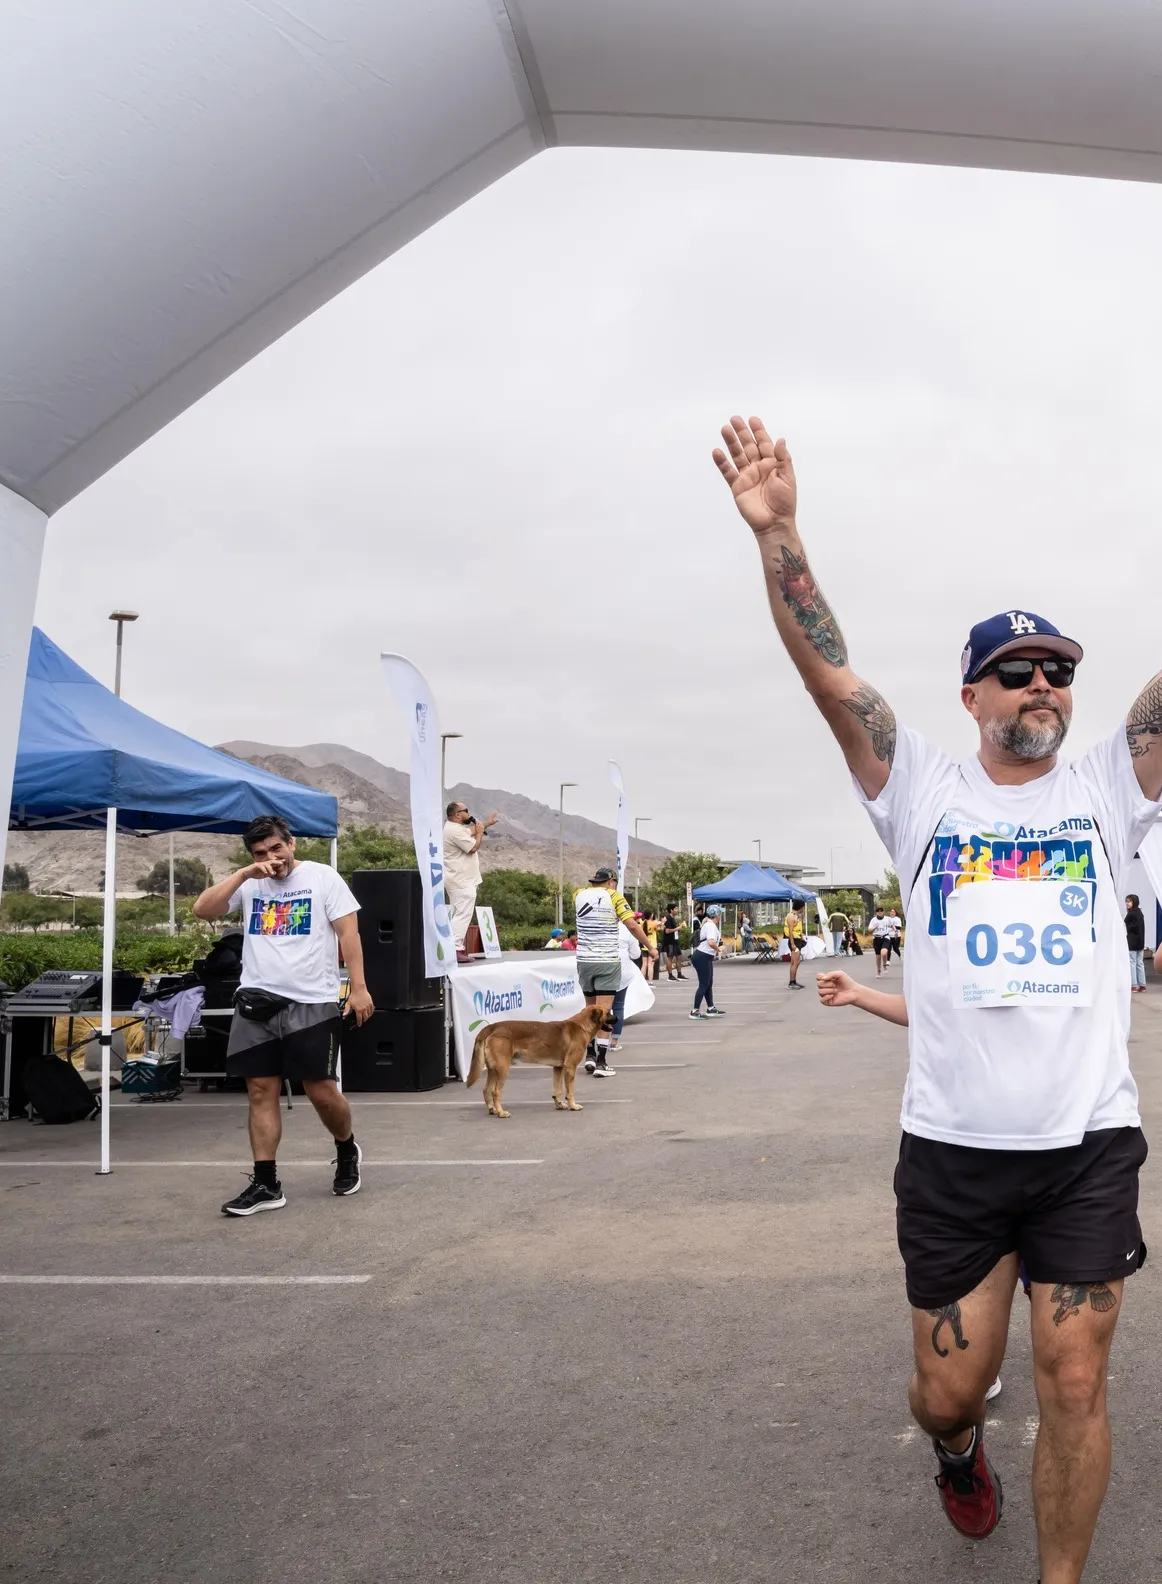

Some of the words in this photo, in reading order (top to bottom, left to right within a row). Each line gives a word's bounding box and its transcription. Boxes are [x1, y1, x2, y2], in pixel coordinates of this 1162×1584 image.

[1006, 612, 1037, 635] LA
[1014, 818, 1093, 841] Atacama
[282, 889, 313, 899] Atacama
[1063, 892, 1084, 910] 3K
[483, 911, 493, 942] 3
[966, 922, 1074, 967] 036
[1021, 980, 1079, 994] Atacama
[484, 989, 523, 1015] Atacama
